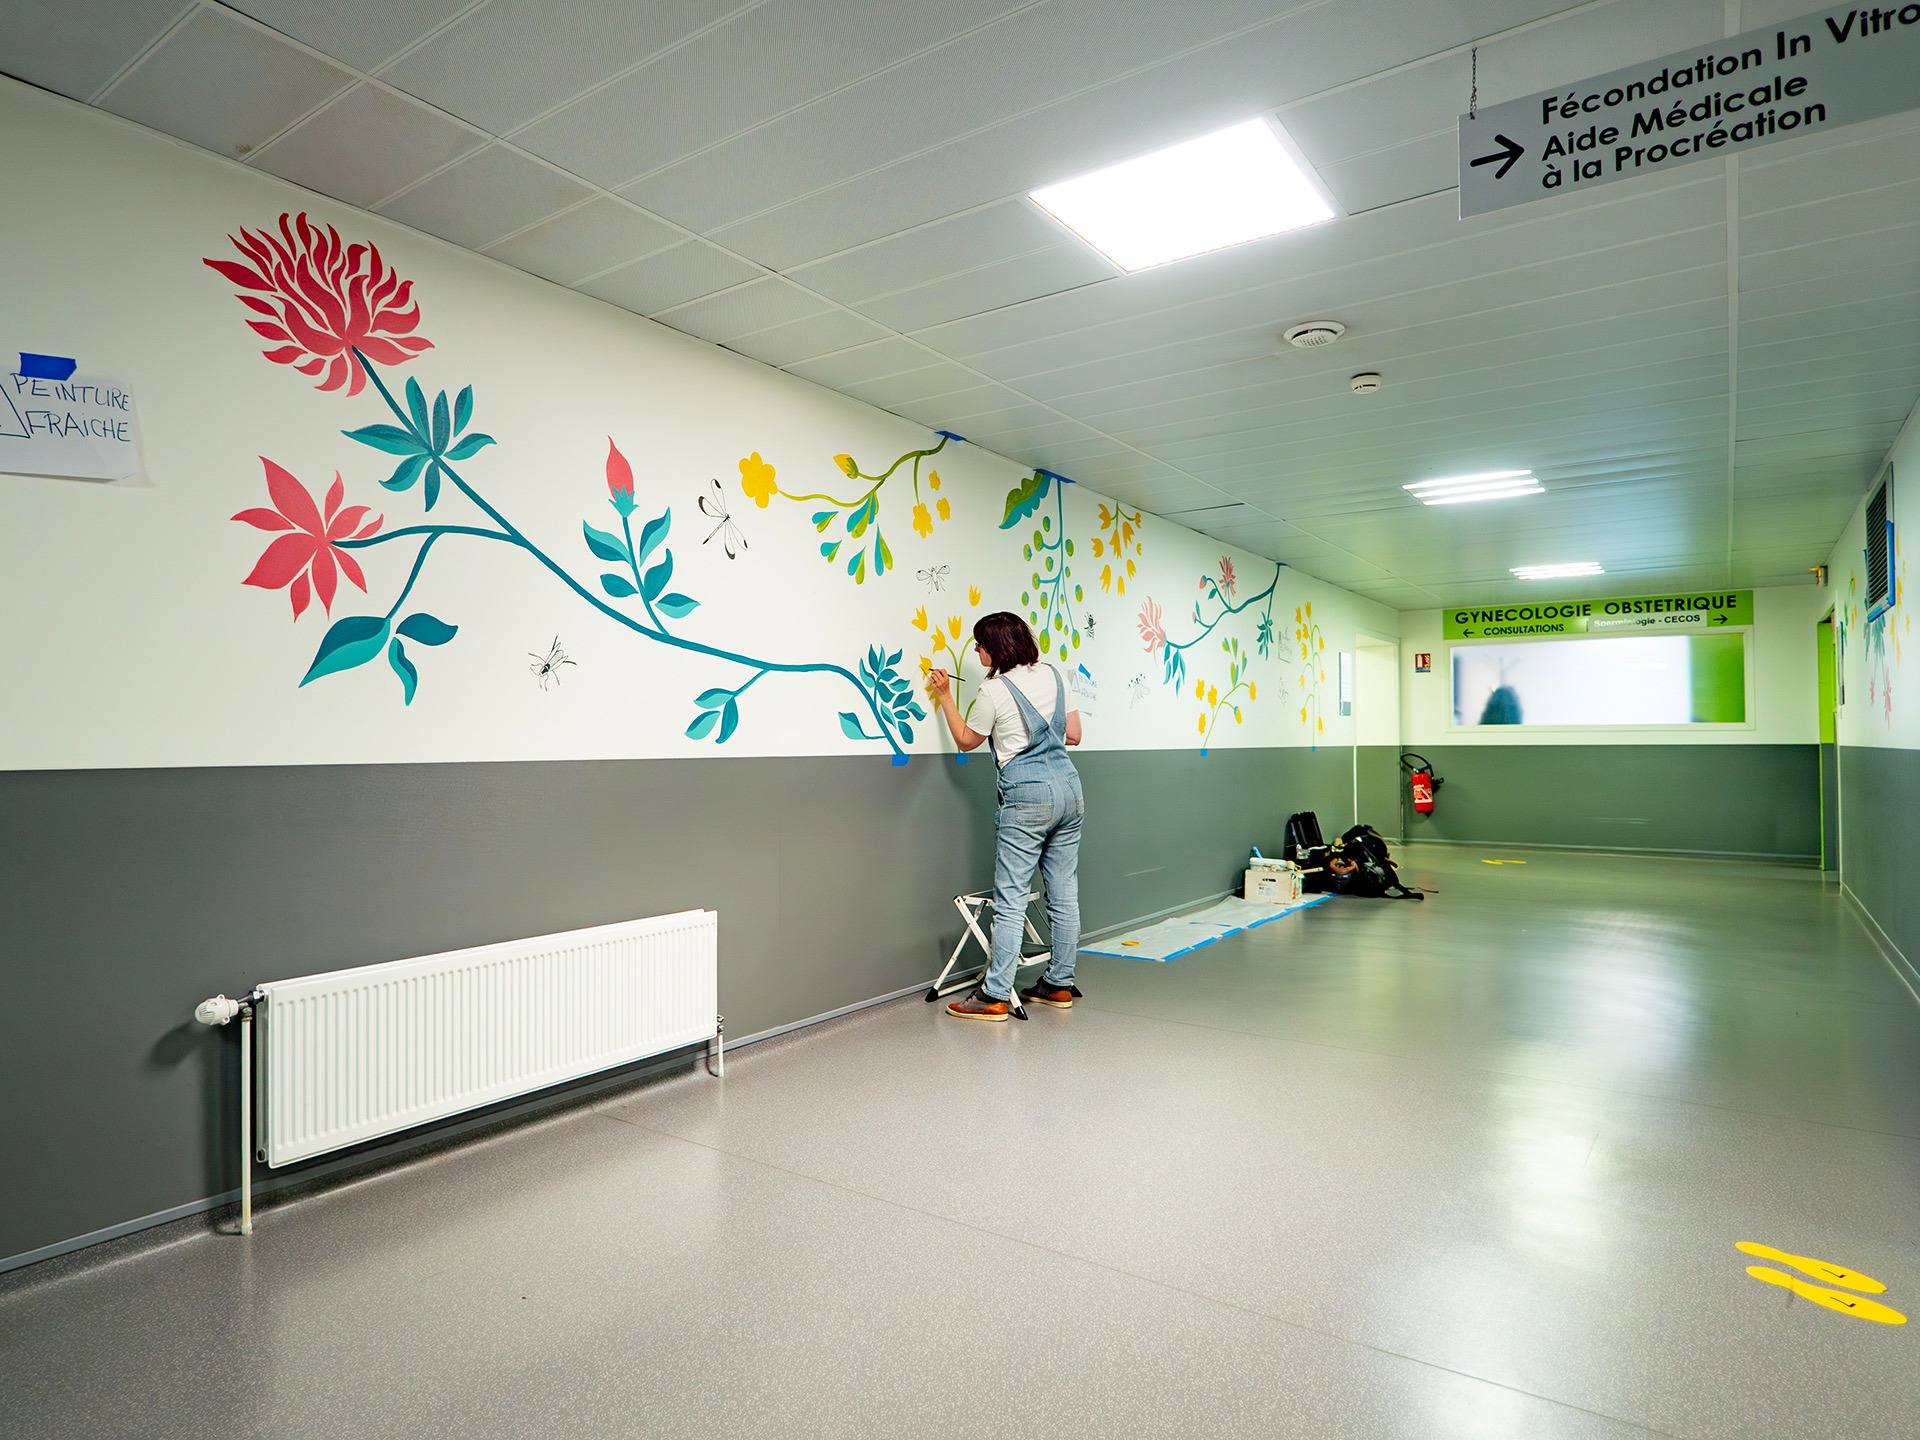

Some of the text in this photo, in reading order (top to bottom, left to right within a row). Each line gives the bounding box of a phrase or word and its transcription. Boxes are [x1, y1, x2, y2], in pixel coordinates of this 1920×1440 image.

[1541, 4, 1920, 125] Fécondation In Vitro
[1541, 75, 1809, 162] Aide Médicale
[1541, 102, 1827, 189] à la Procréation
[9, 372, 130, 411] PEINTURE
[25, 410, 131, 442] FRAICHE
[1455, 595, 1737, 624] GYNECOLOGIE OBSTETRIQUE
[1664, 614, 1701, 624] CECOS
[1483, 623, 1565, 636] CONSULTATIONS
